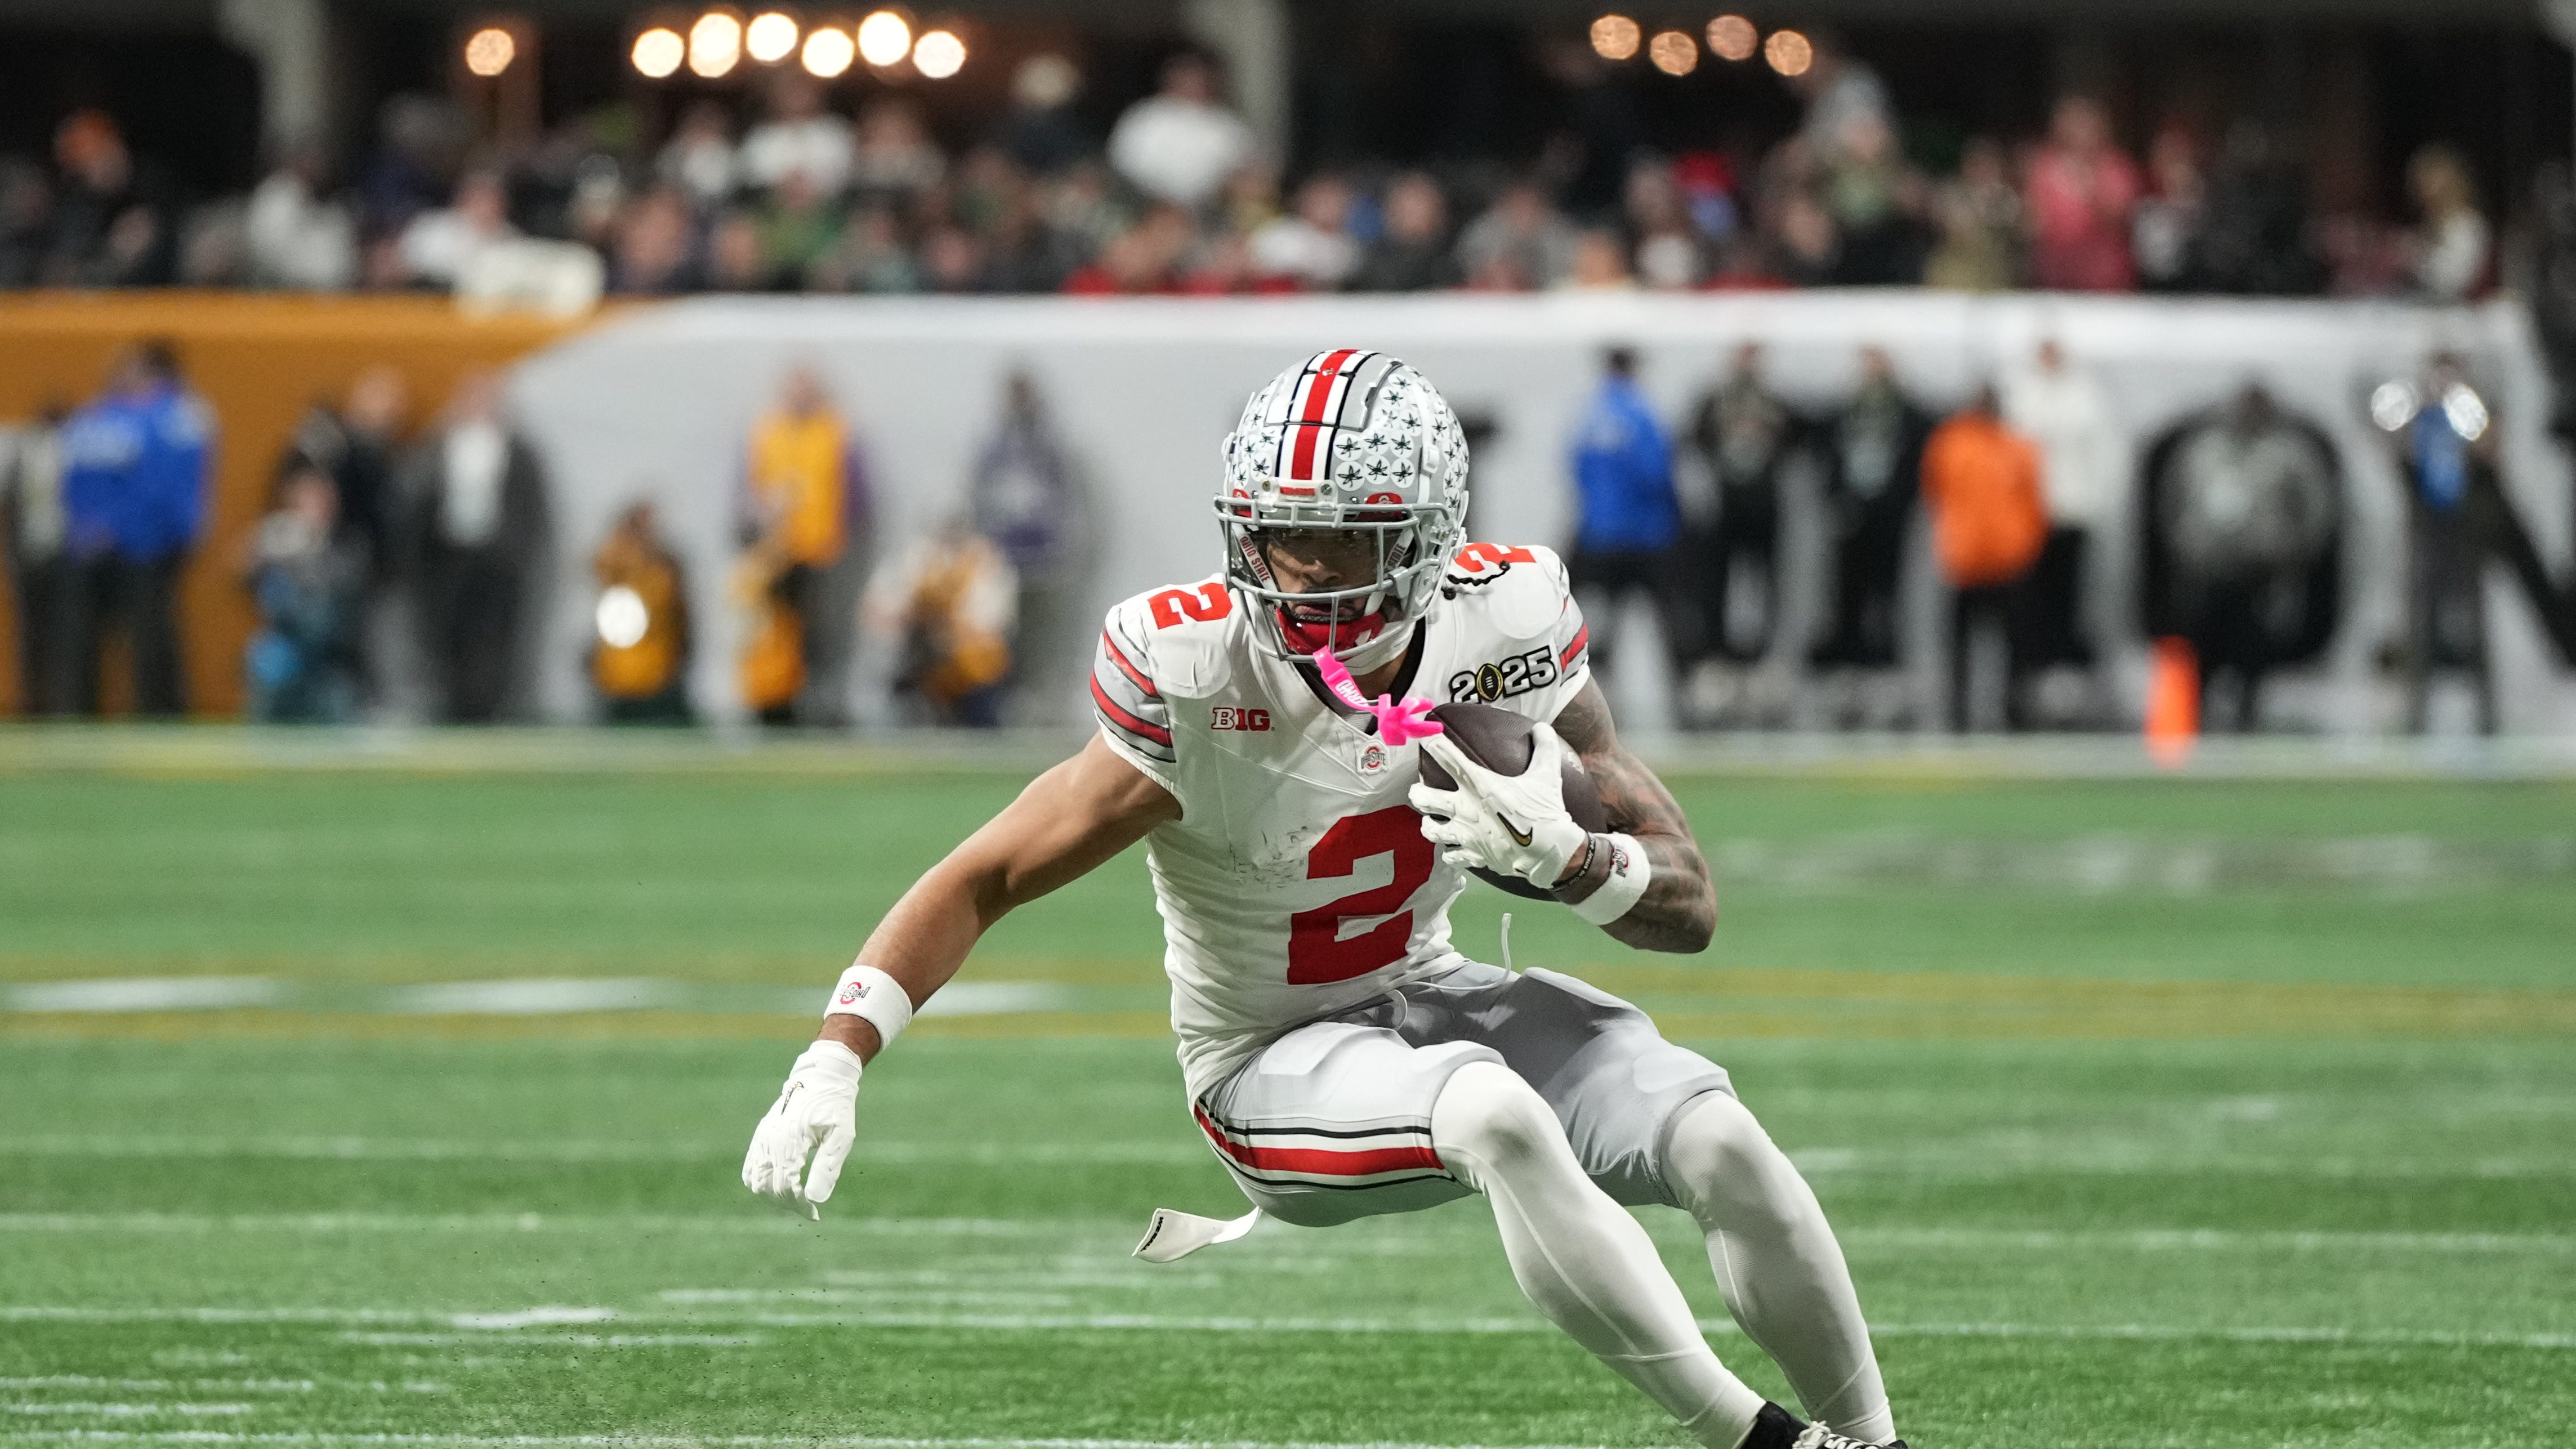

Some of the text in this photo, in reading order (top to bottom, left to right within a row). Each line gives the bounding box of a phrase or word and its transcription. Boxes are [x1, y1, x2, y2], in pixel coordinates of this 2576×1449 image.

[1240, 536, 1271, 582] OHIO STATE
[1147, 582, 1233, 630] 2
[1449, 645, 1556, 704] 2025
[1287, 804, 1435, 985] 2
